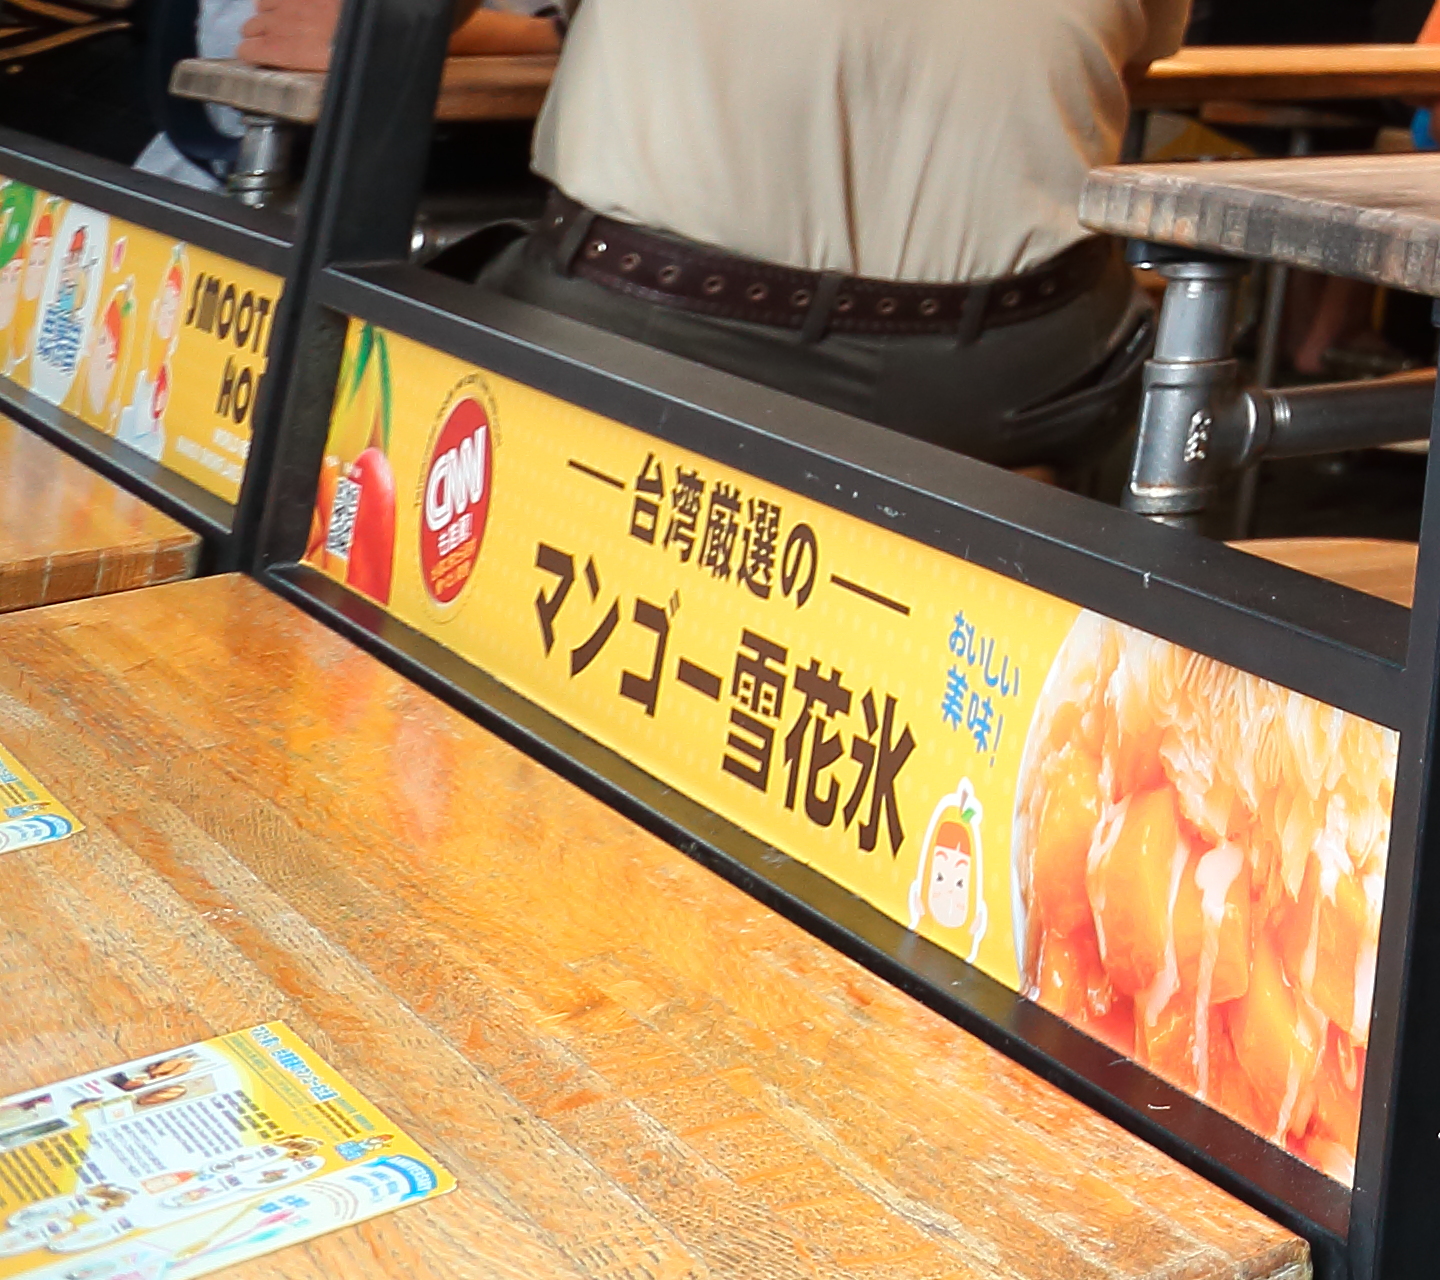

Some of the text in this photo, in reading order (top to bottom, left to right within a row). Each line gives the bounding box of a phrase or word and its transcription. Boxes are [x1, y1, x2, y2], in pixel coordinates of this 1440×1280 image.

[426, 424, 487, 532] CNN
[629, 451, 818, 610] 台湾厳選の
[534, 542, 916, 859] マンゴー雪花氷
[948, 609, 1020, 698] おいしい
